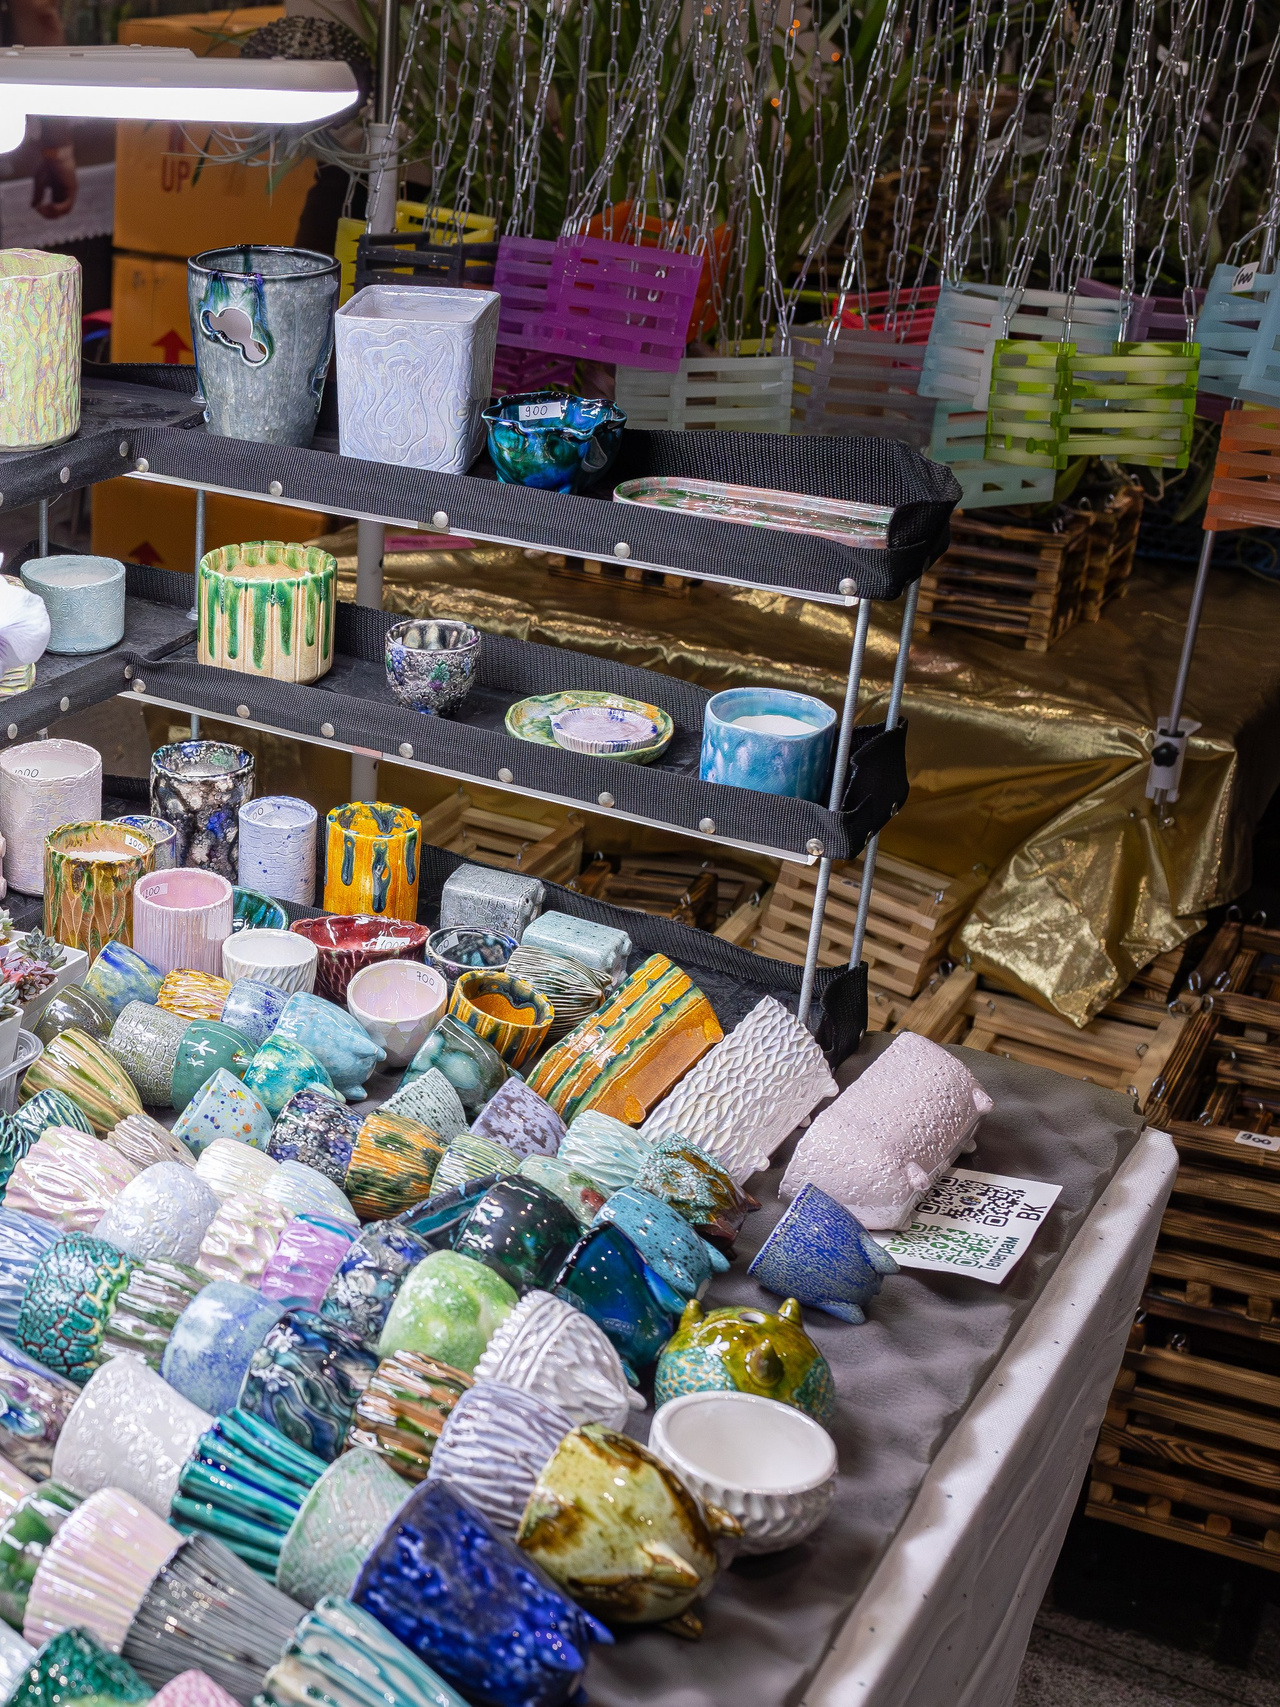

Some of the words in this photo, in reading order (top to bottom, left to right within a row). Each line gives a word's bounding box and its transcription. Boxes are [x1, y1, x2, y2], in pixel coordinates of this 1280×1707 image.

[161, 156, 191, 194] UP
[524, 405, 548, 418] 900
[1015, 1203, 1048, 1222] ВК
[977, 1236, 1021, 1271] Телеграм
